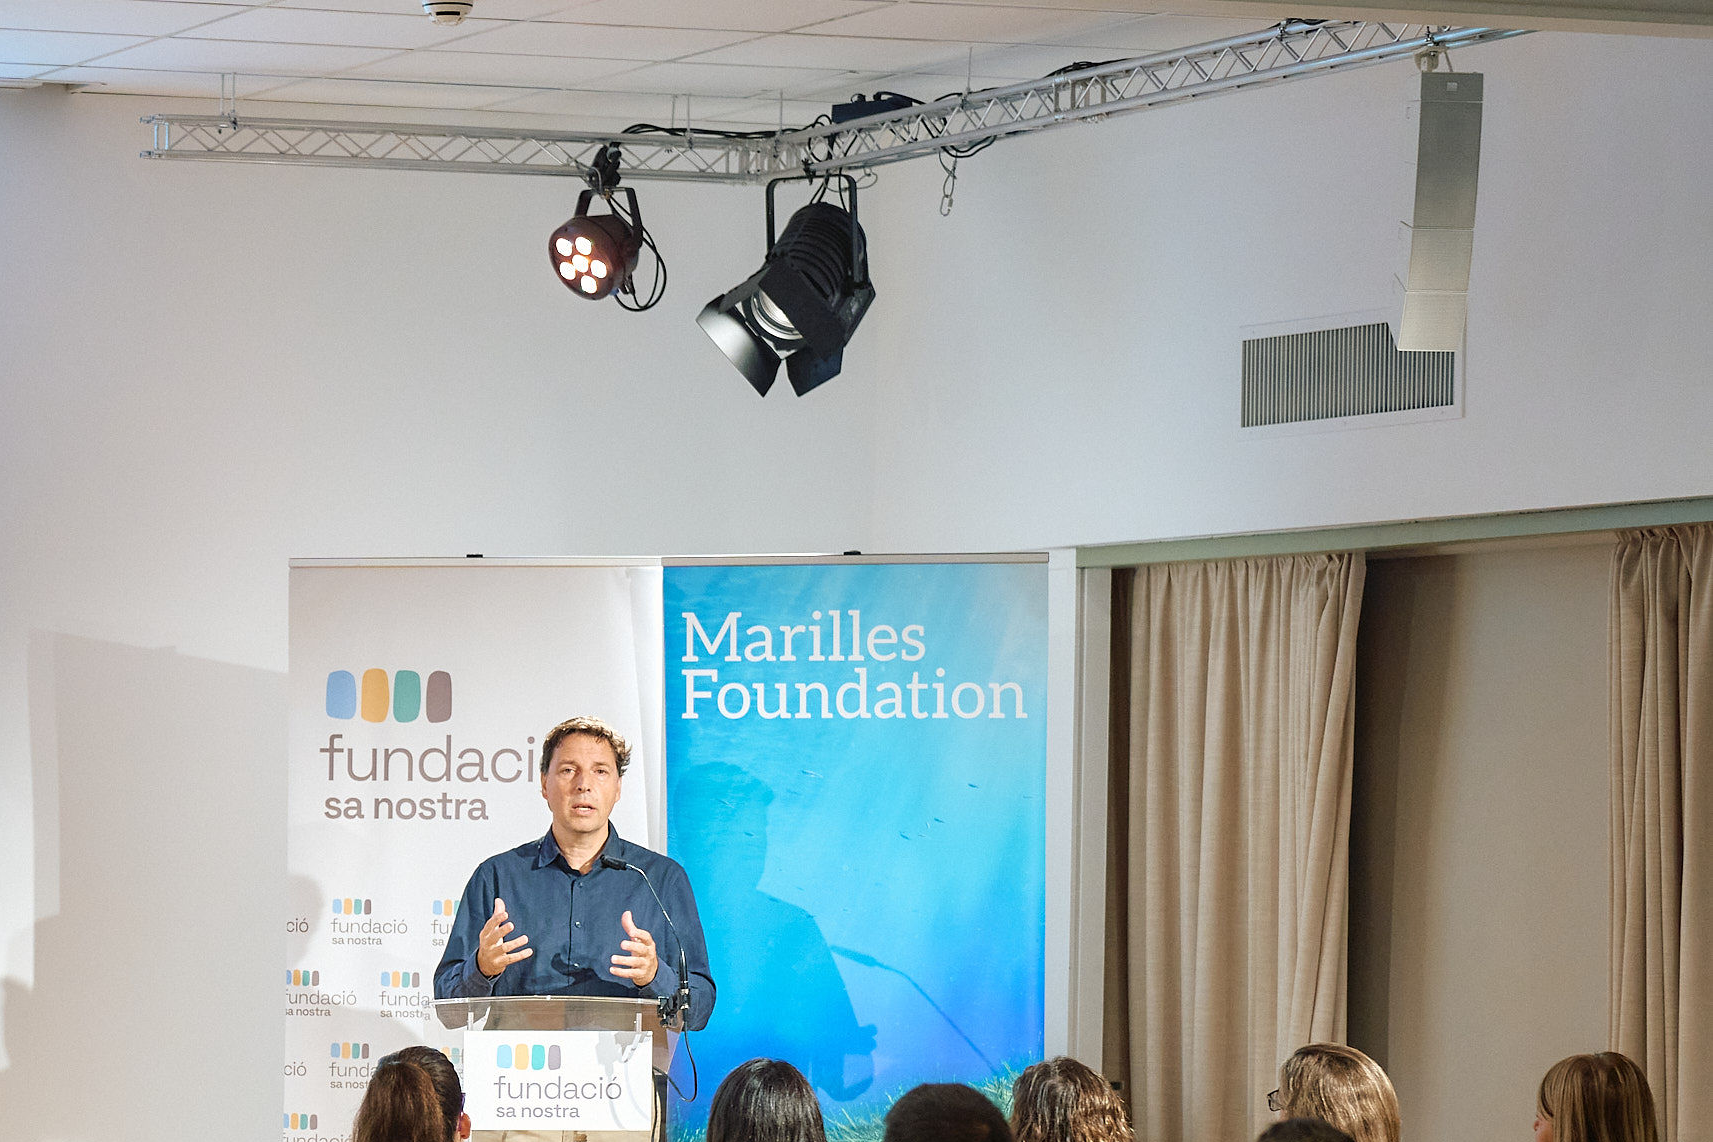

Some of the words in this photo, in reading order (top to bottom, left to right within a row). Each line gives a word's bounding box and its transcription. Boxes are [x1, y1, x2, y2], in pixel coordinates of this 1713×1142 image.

[681, 609, 926, 663] Marilles
[681, 667, 1029, 720] Foundation
[319, 734, 536, 783] fundaci
[324, 797, 364, 819] sa
[373, 792, 489, 820] nostra
[330, 918, 408, 934] fundació
[332, 937, 345, 945] sa
[347, 936, 382, 945] nostra
[432, 938, 445, 946] sa
[379, 991, 431, 1006] funda
[296, 1007, 331, 1017] nostra
[380, 1010, 393, 1018] sa
[330, 1081, 343, 1089] sa
[345, 1080, 369, 1089] nost
[493, 1075, 622, 1100] fundació
[496, 1107, 517, 1118] sa
[521, 1104, 581, 1119] nostra
